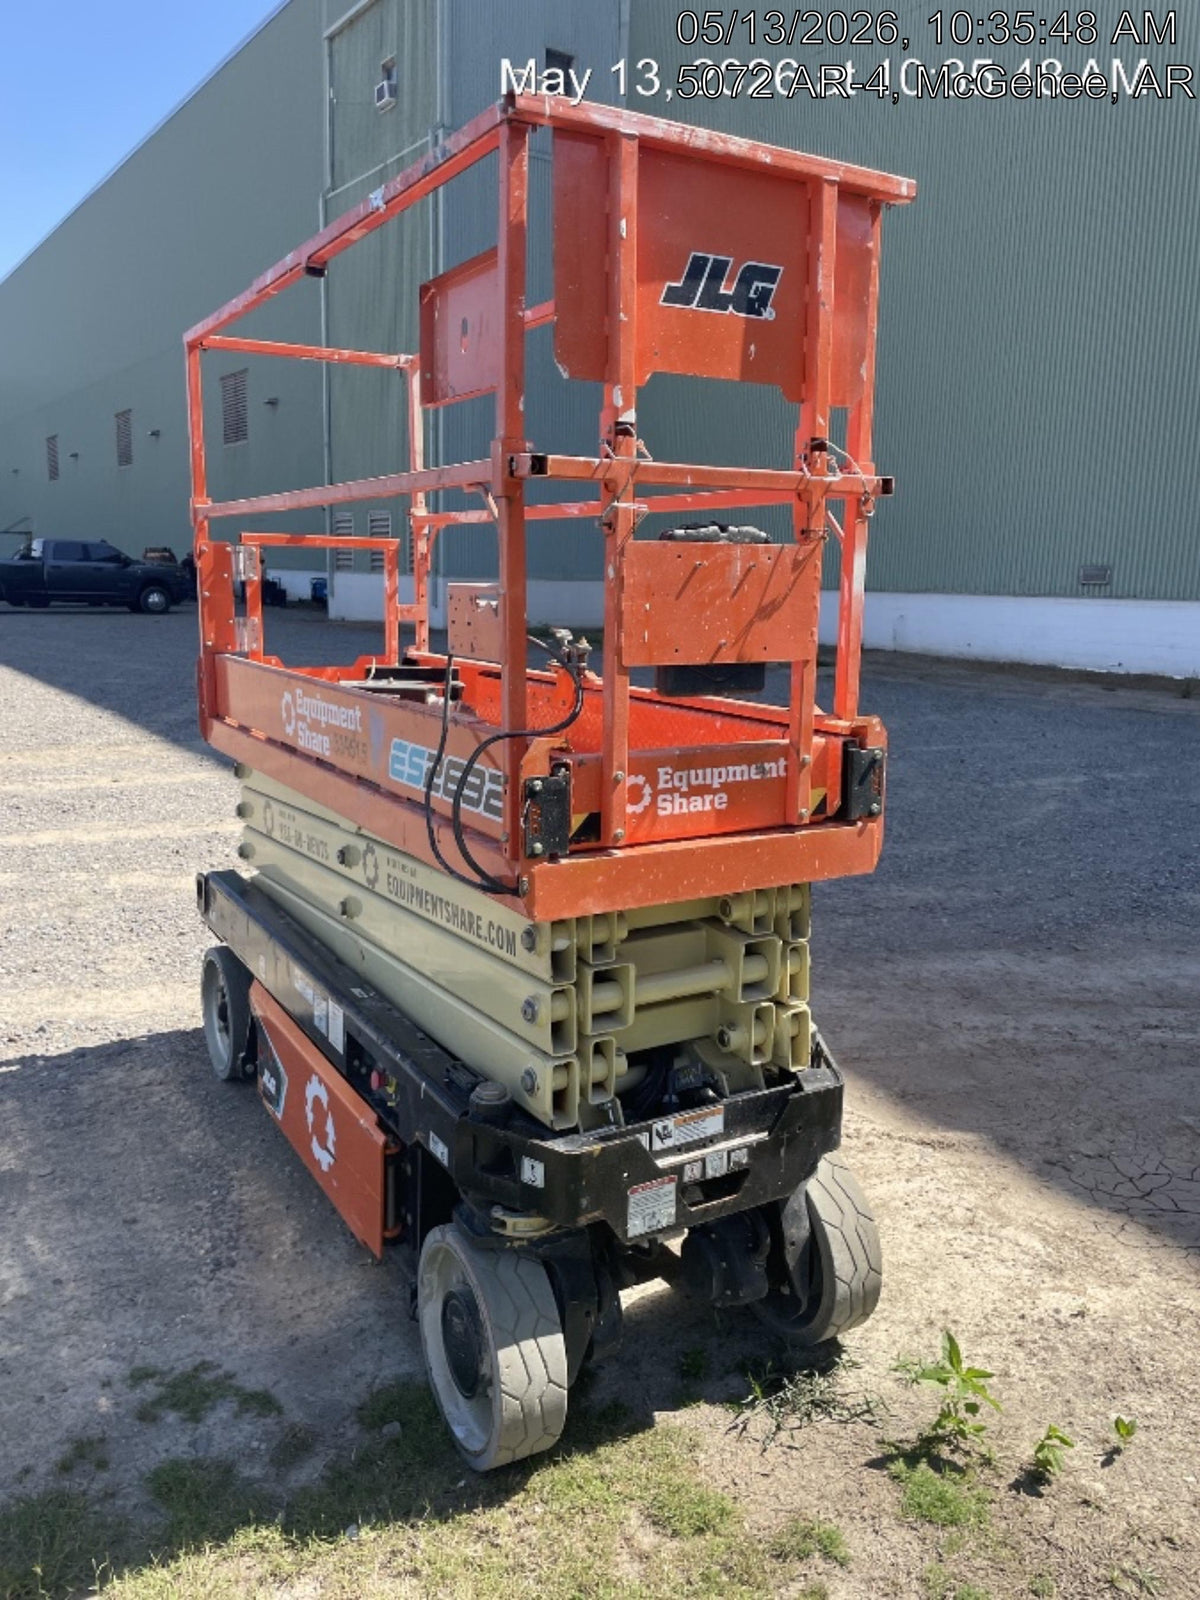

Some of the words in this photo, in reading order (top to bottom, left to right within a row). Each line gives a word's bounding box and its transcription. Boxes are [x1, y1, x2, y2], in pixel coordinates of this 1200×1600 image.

[659, 252, 784, 320] JLG
[295, 687, 362, 733] Equipment
[298, 721, 330, 757] Share
[657, 757, 788, 791] Equipment
[657, 792, 728, 817] Share
[386, 873, 517, 957] EQUIPMENTSHARE.COM
